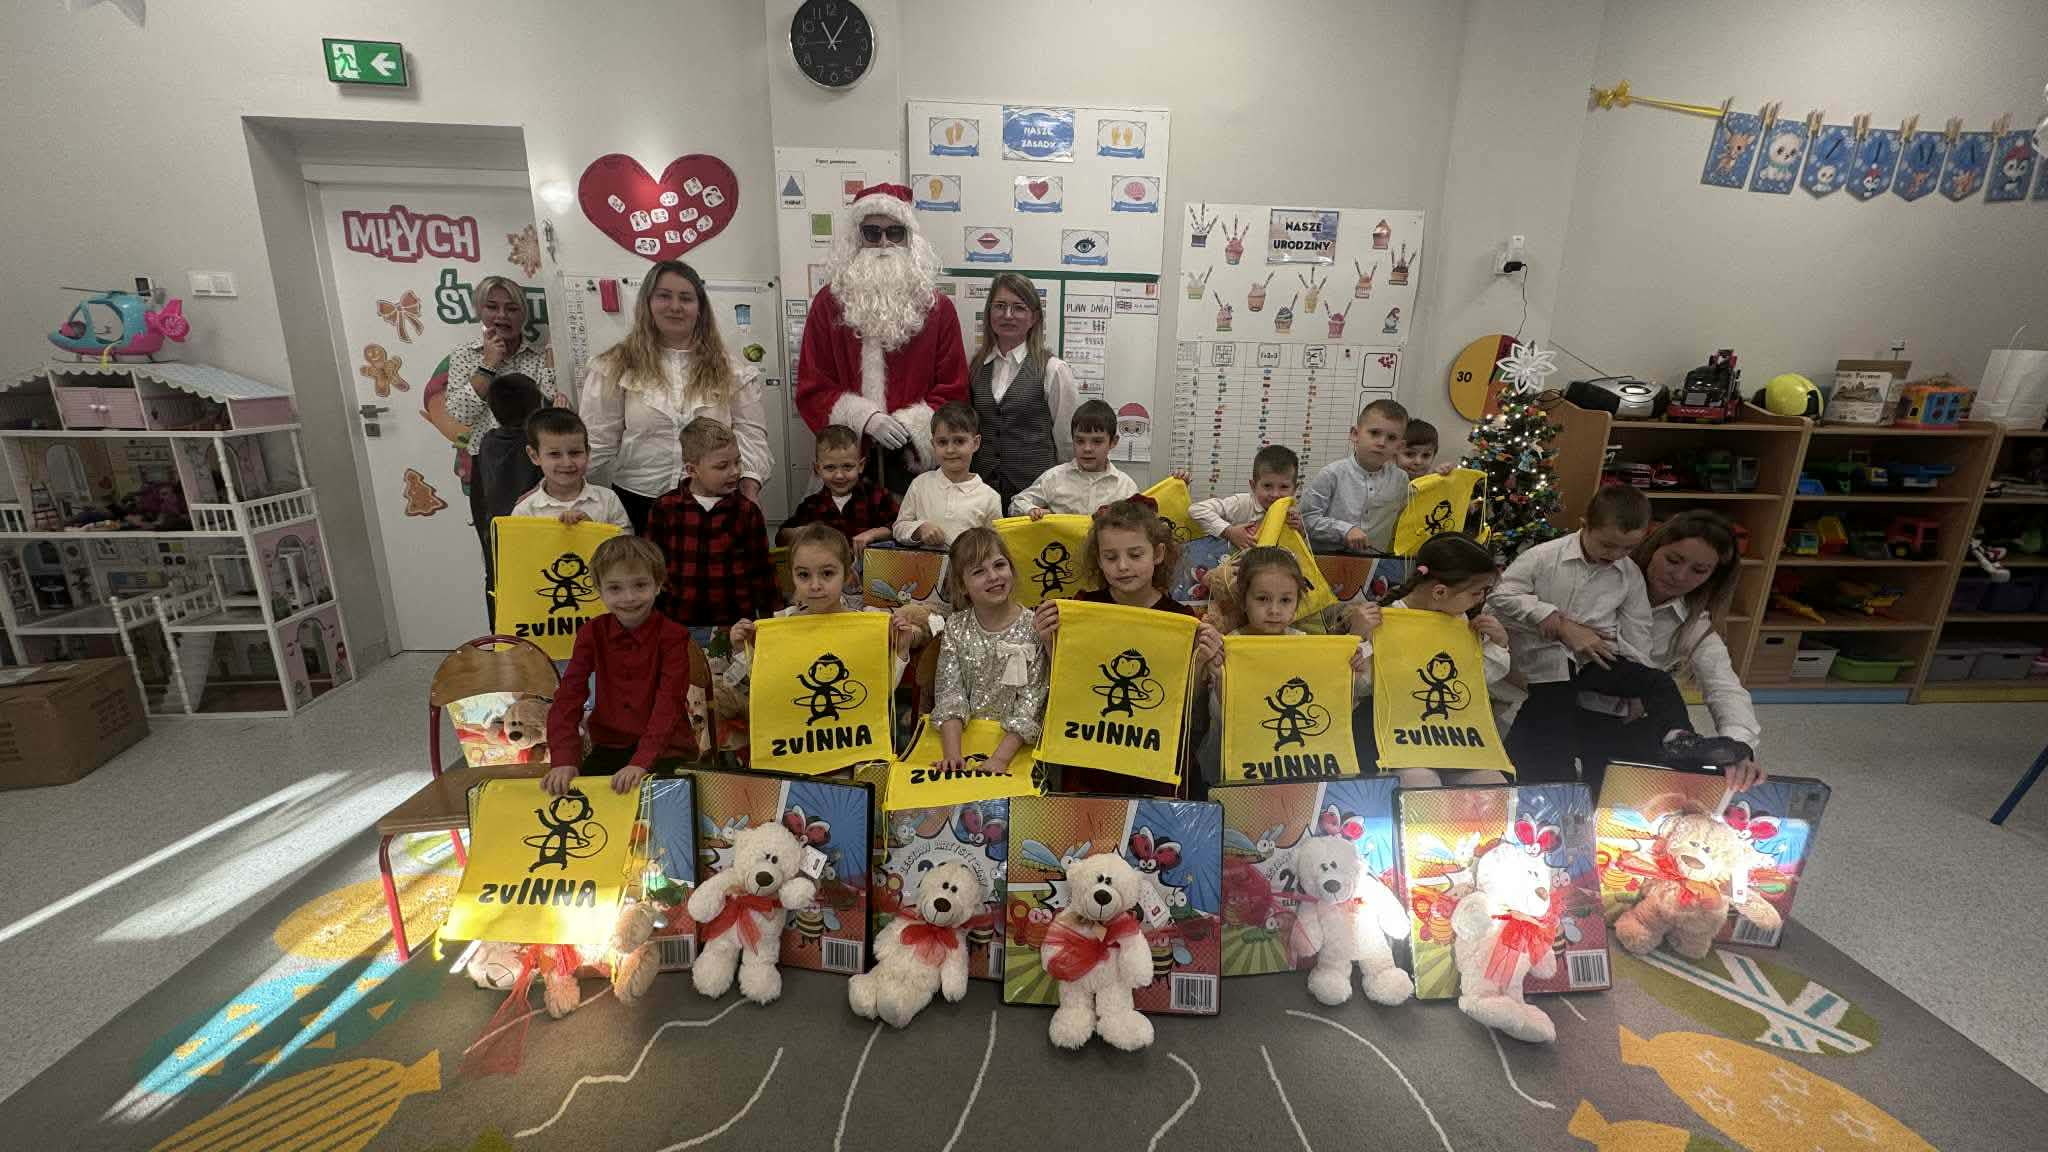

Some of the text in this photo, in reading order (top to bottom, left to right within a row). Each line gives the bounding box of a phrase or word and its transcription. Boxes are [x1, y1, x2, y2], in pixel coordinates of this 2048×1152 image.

[1022, 139, 1057, 149] ZASADY
[1285, 221, 1322, 232] NASZE
[349, 210, 476, 258] MIŁYCH
[1273, 239, 1331, 251] URODZINY
[1066, 303, 1087, 313] PLAN
[1456, 371, 1473, 383] 30
